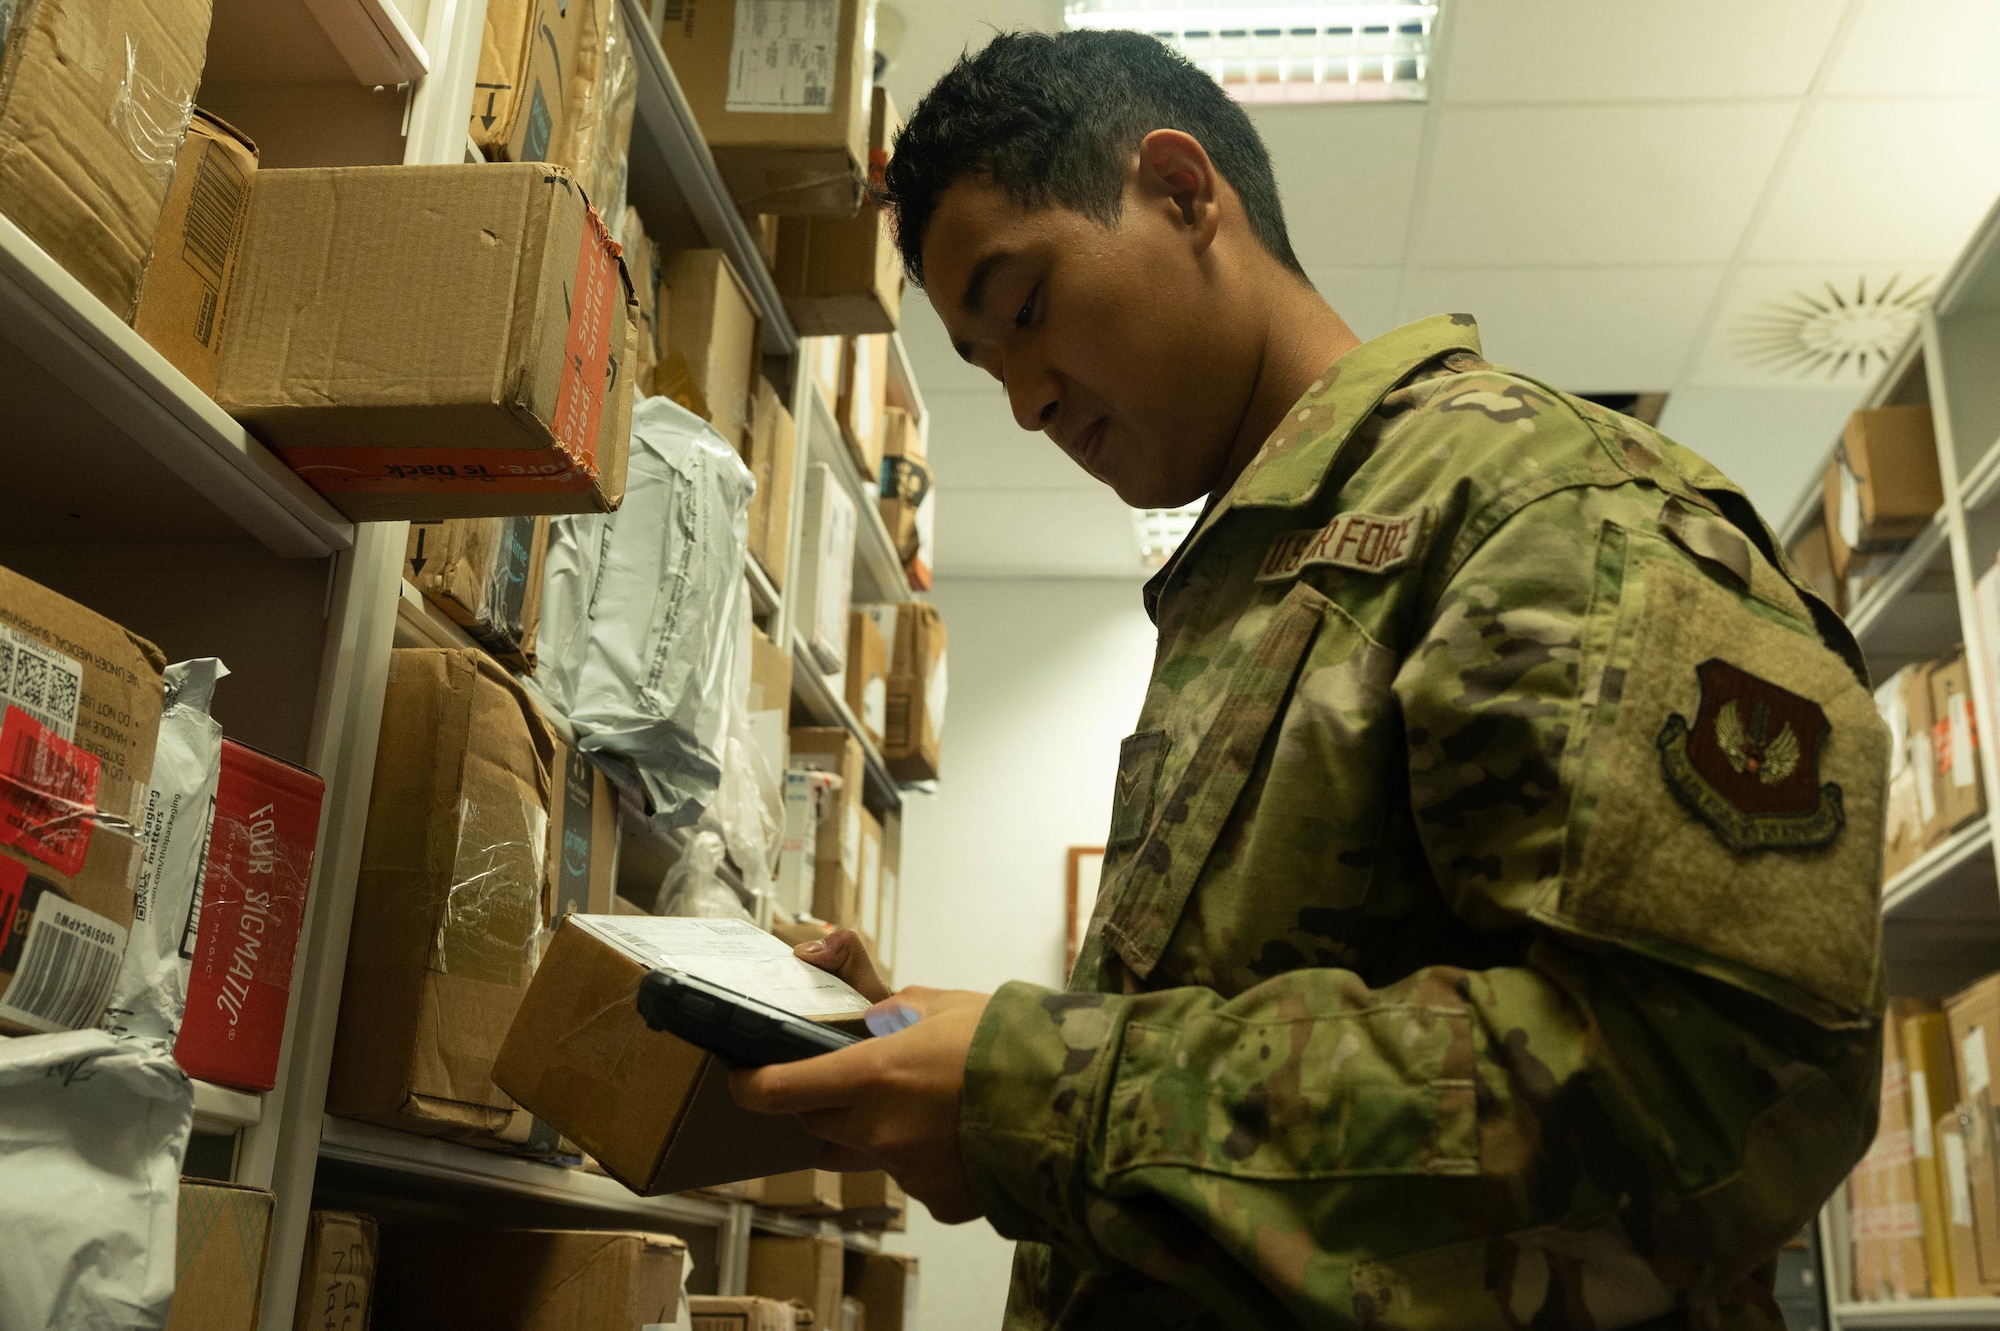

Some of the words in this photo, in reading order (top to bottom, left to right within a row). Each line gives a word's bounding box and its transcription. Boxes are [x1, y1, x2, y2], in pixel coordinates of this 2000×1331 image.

[578, 250, 598, 347] Spend
[383, 462, 457, 478] back
[53, 638, 94, 664] MEDICAL
[95, 658, 125, 678] UNDER
[92, 721, 128, 748] HANDLE
[148, 810, 164, 865] matters
[248, 802, 275, 875] FOUR
